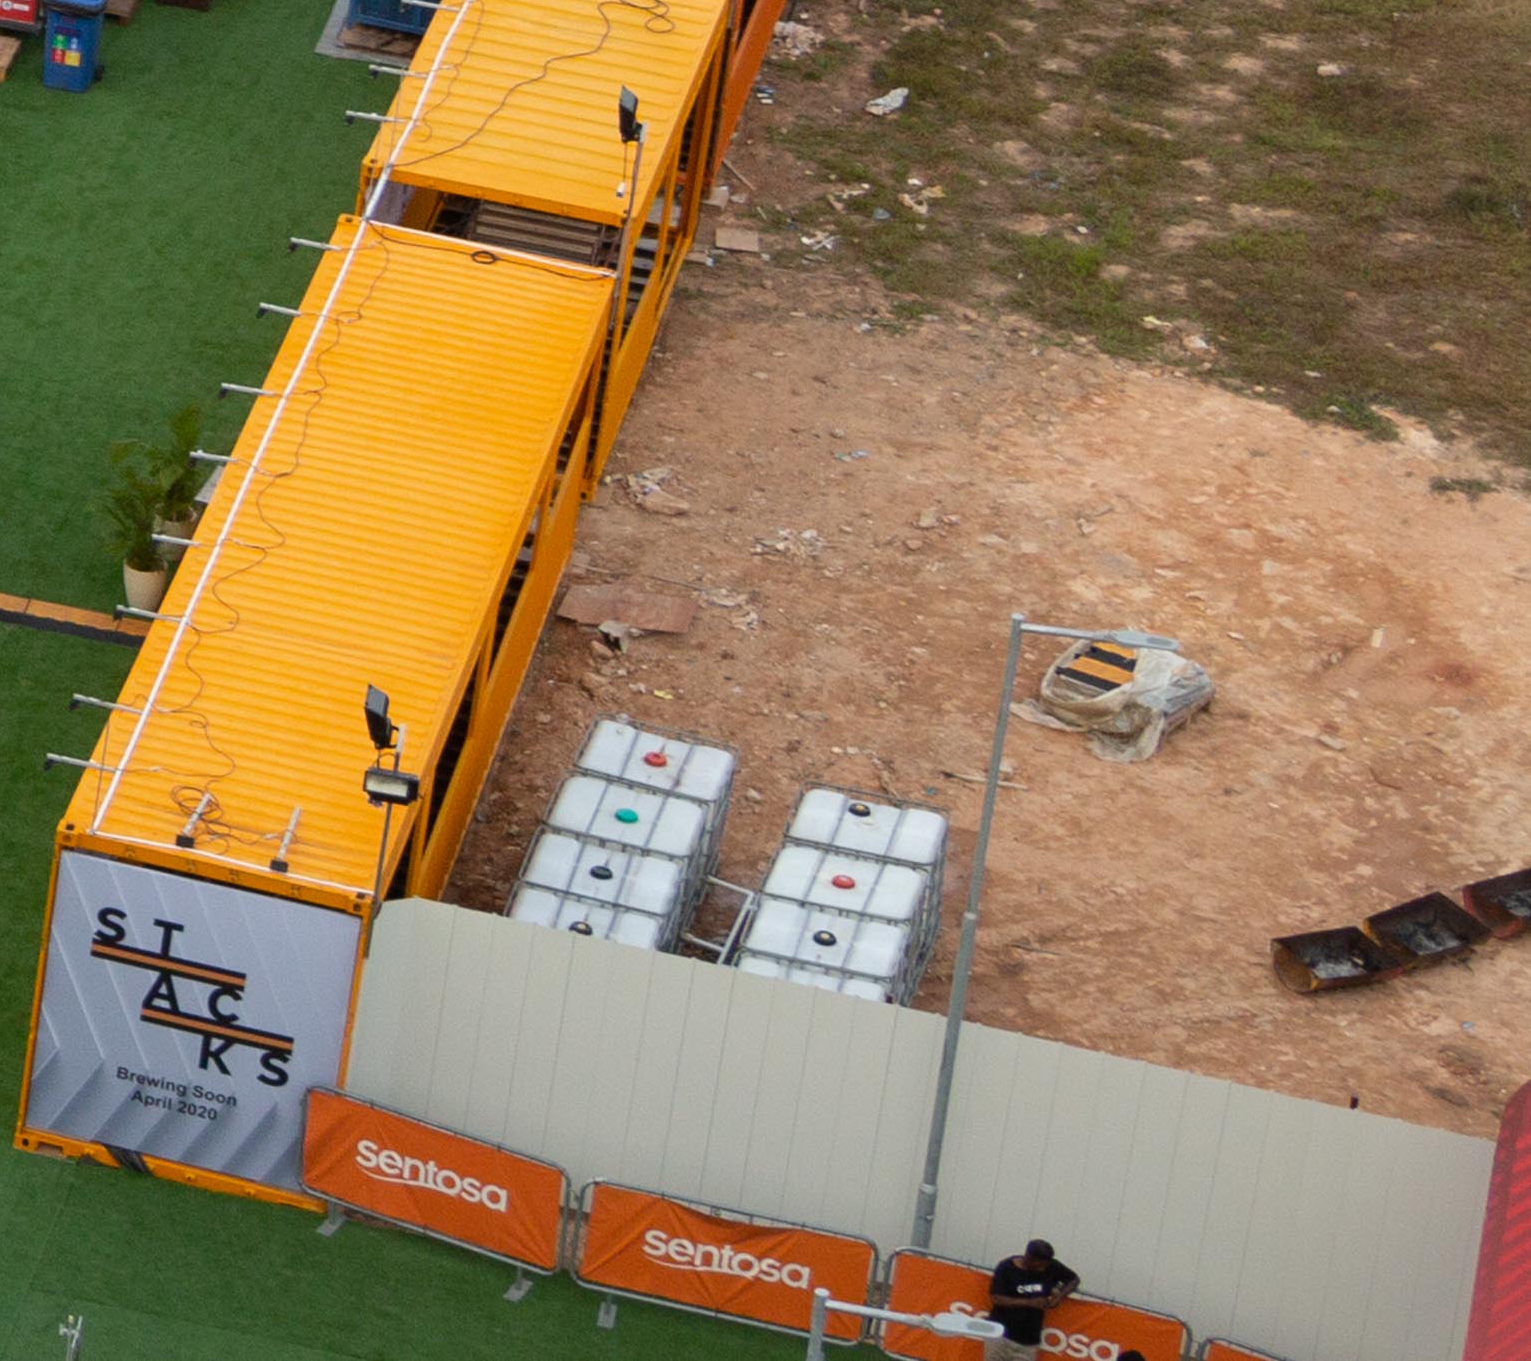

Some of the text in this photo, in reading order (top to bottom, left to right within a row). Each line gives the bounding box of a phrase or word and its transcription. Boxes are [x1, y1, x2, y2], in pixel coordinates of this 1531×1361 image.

[115, 1066, 238, 1107] Brewing Soon
[130, 1089, 219, 1121] April 2020
[355, 1139, 509, 1213] sentosa
[641, 1229, 812, 1290] sentosa
